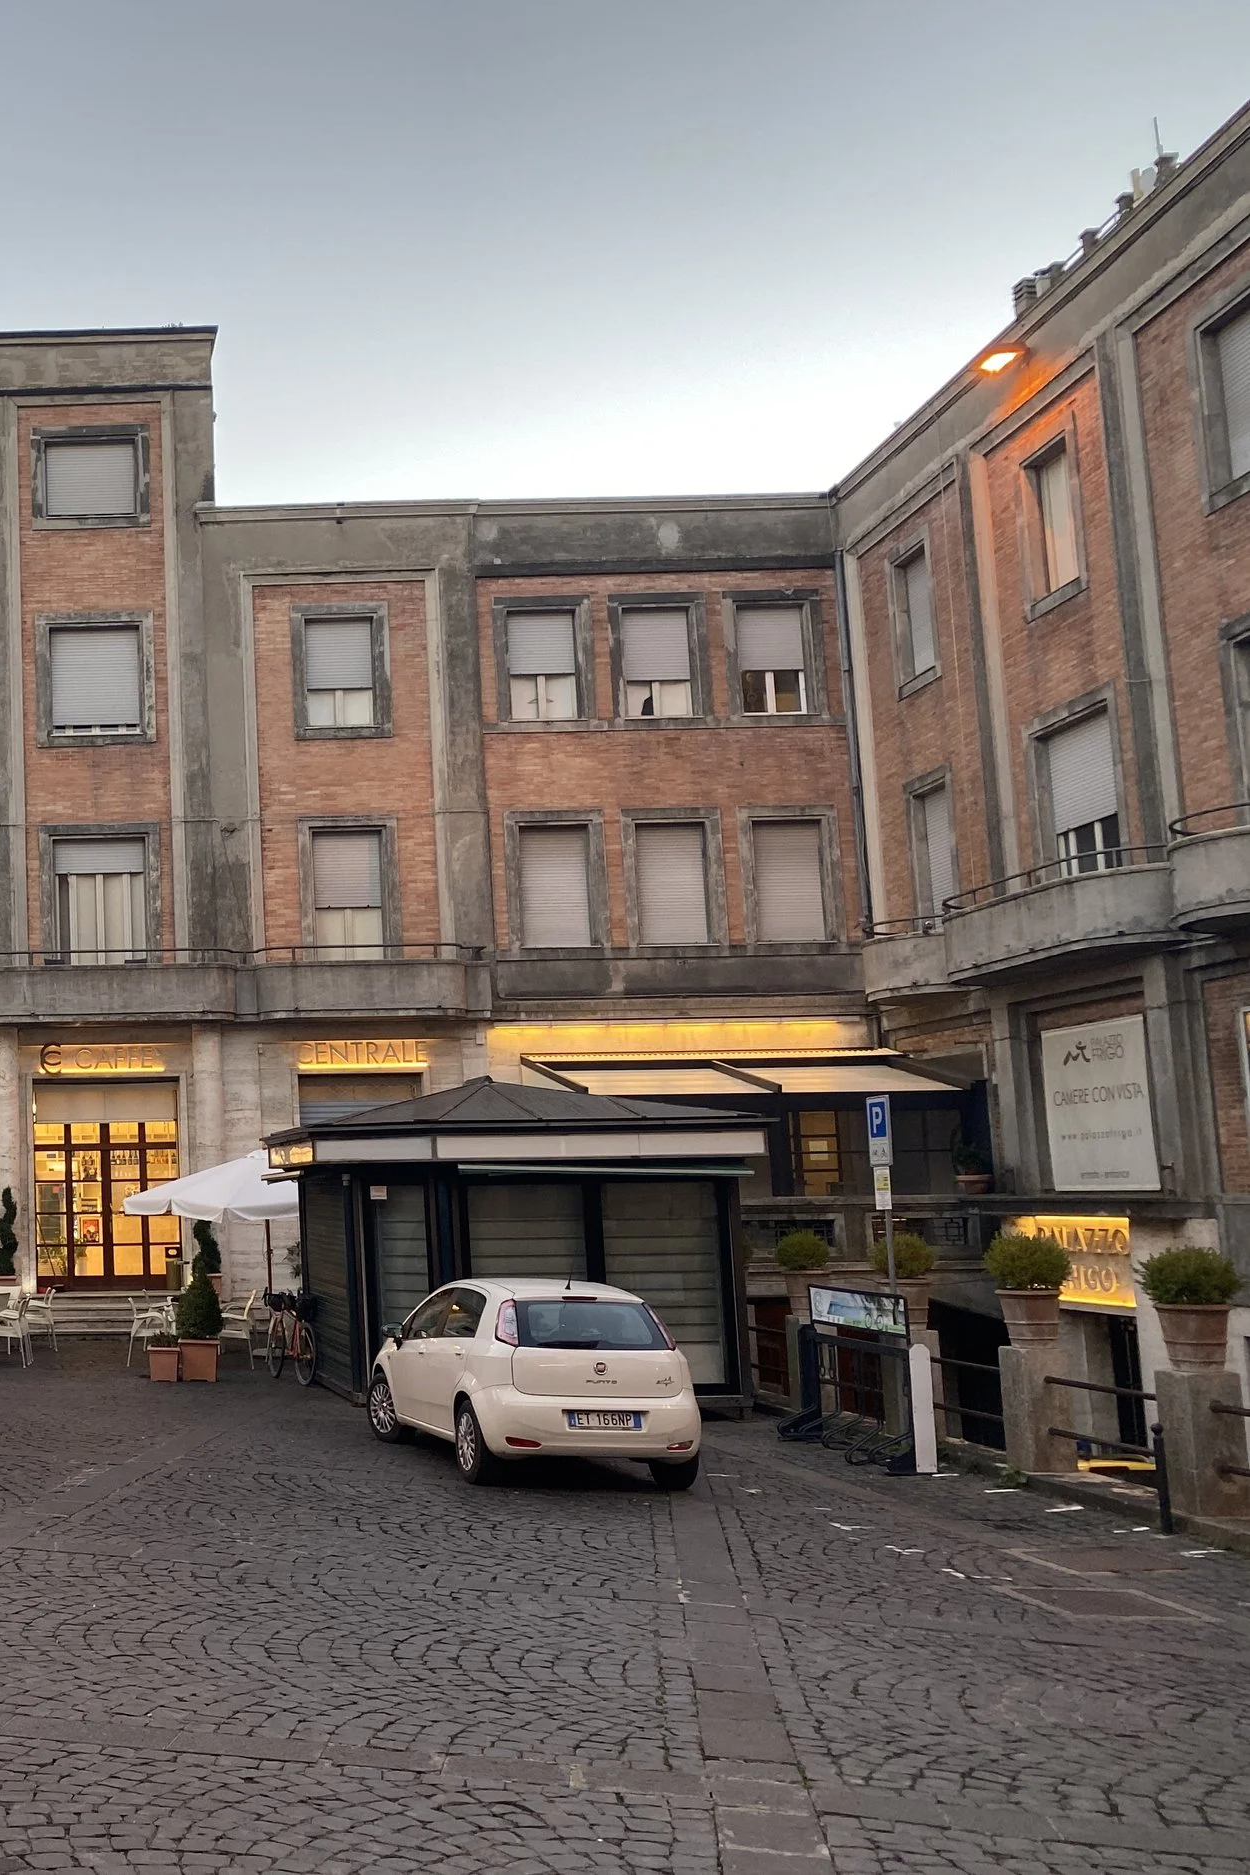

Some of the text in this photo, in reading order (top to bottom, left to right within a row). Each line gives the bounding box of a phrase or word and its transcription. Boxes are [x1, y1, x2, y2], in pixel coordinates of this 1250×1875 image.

[298, 1040, 428, 1064] CENTRALE
[871, 1106, 883, 1134] P
[577, 1412, 632, 1426] ET 166NP
